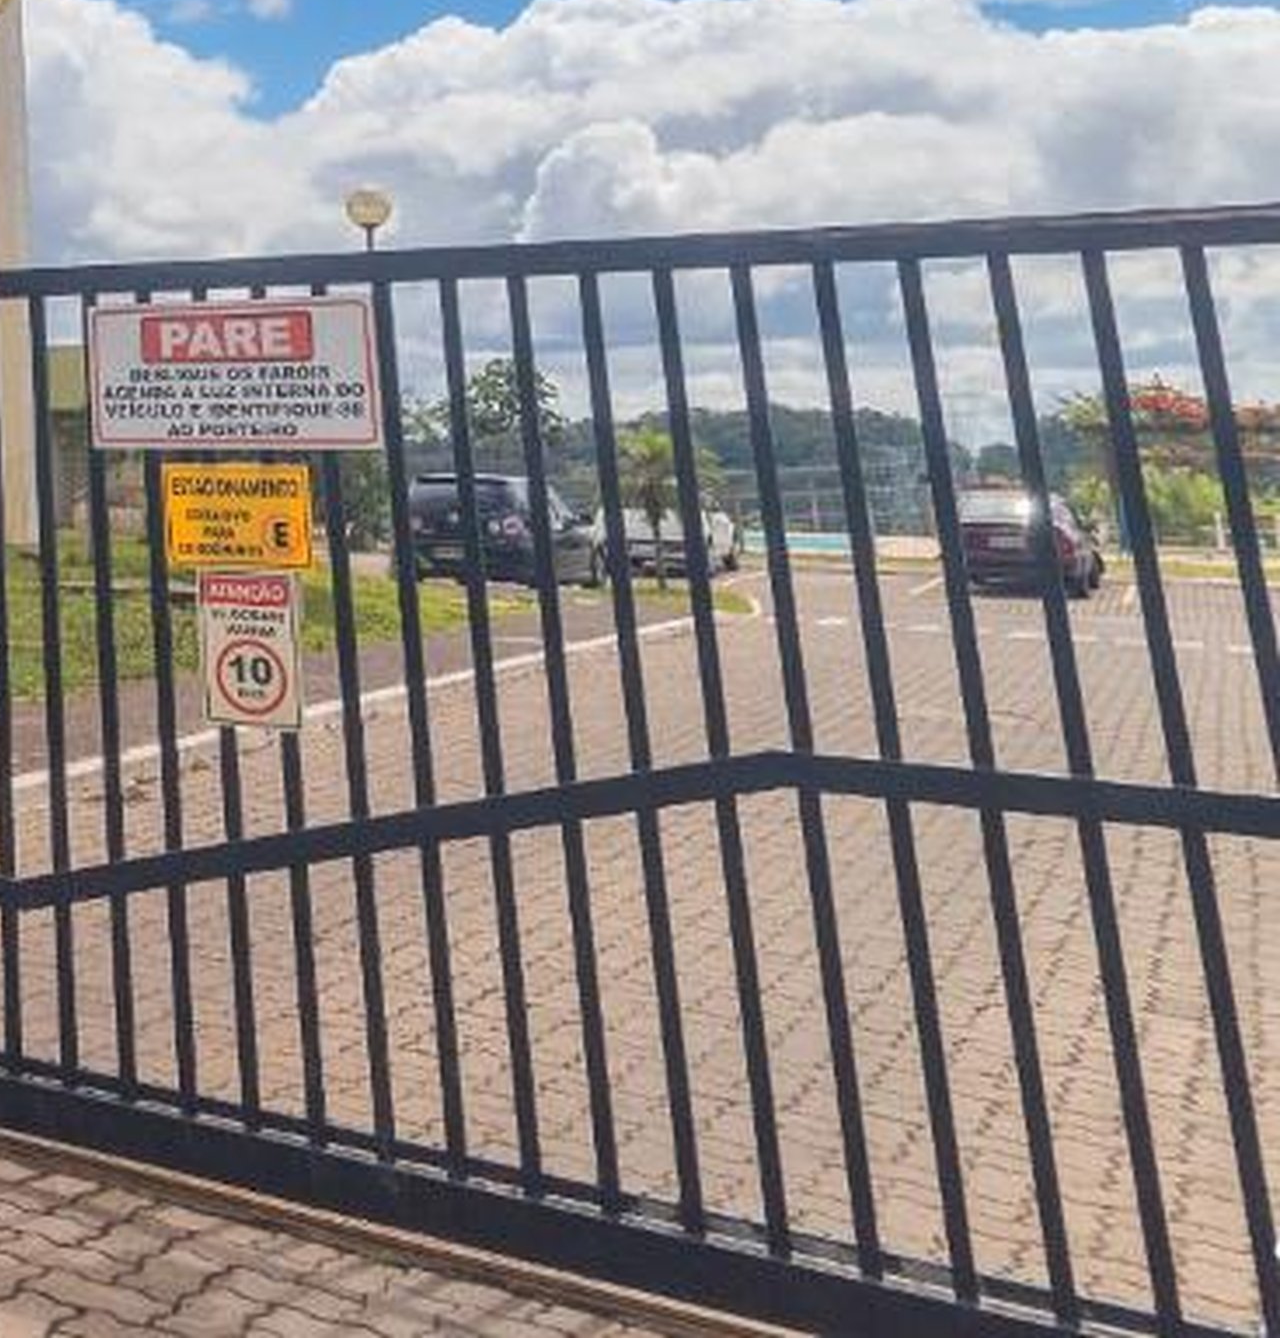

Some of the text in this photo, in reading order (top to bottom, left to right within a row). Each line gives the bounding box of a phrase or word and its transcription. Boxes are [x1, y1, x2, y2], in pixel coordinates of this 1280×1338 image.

[159, 315, 291, 361] PARE
[226, 365, 253, 381] OS
[181, 384, 195, 400] A
[199, 384, 239, 399] LUZ
[240, 382, 331, 399] INTERNA
[335, 381, 366, 399] DO
[189, 403, 203, 419] E
[166, 423, 195, 439] AO
[171, 475, 299, 499] ESTACIONAMENTO
[273, 521, 290, 549] E
[208, 579, 287, 604] ATENÇÃO
[227, 654, 274, 687] 10
